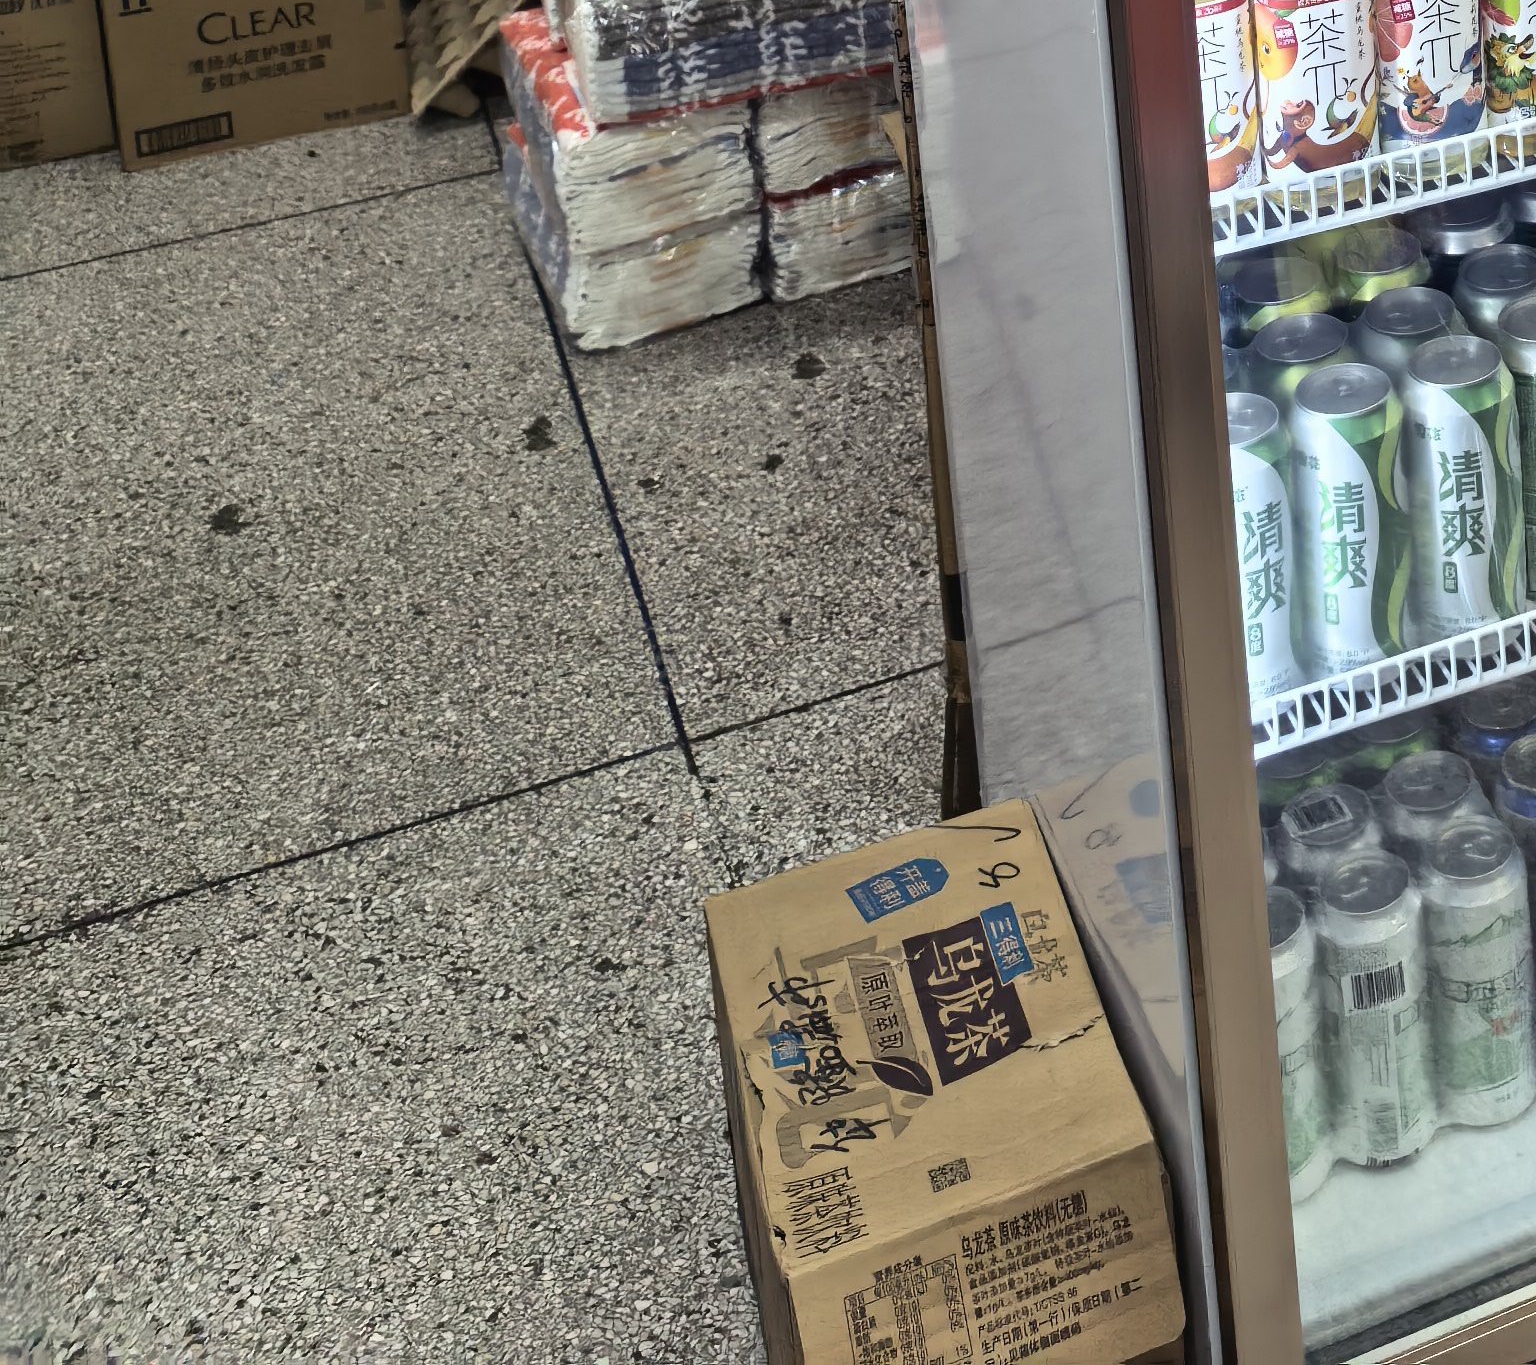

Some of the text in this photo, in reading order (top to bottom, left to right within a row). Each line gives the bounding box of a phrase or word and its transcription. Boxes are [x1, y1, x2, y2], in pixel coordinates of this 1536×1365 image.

[197, 2, 315, 45] CLEAR
[1320, 482, 1367, 589] 清爽
[1438, 450, 1485, 557] 清爽
[1242, 500, 1286, 619] 清爽
[989, 917, 1026, 970] 三得利
[861, 972, 904, 1052] 原叶萃取
[928, 936, 1011, 1066] 乌龙茶
